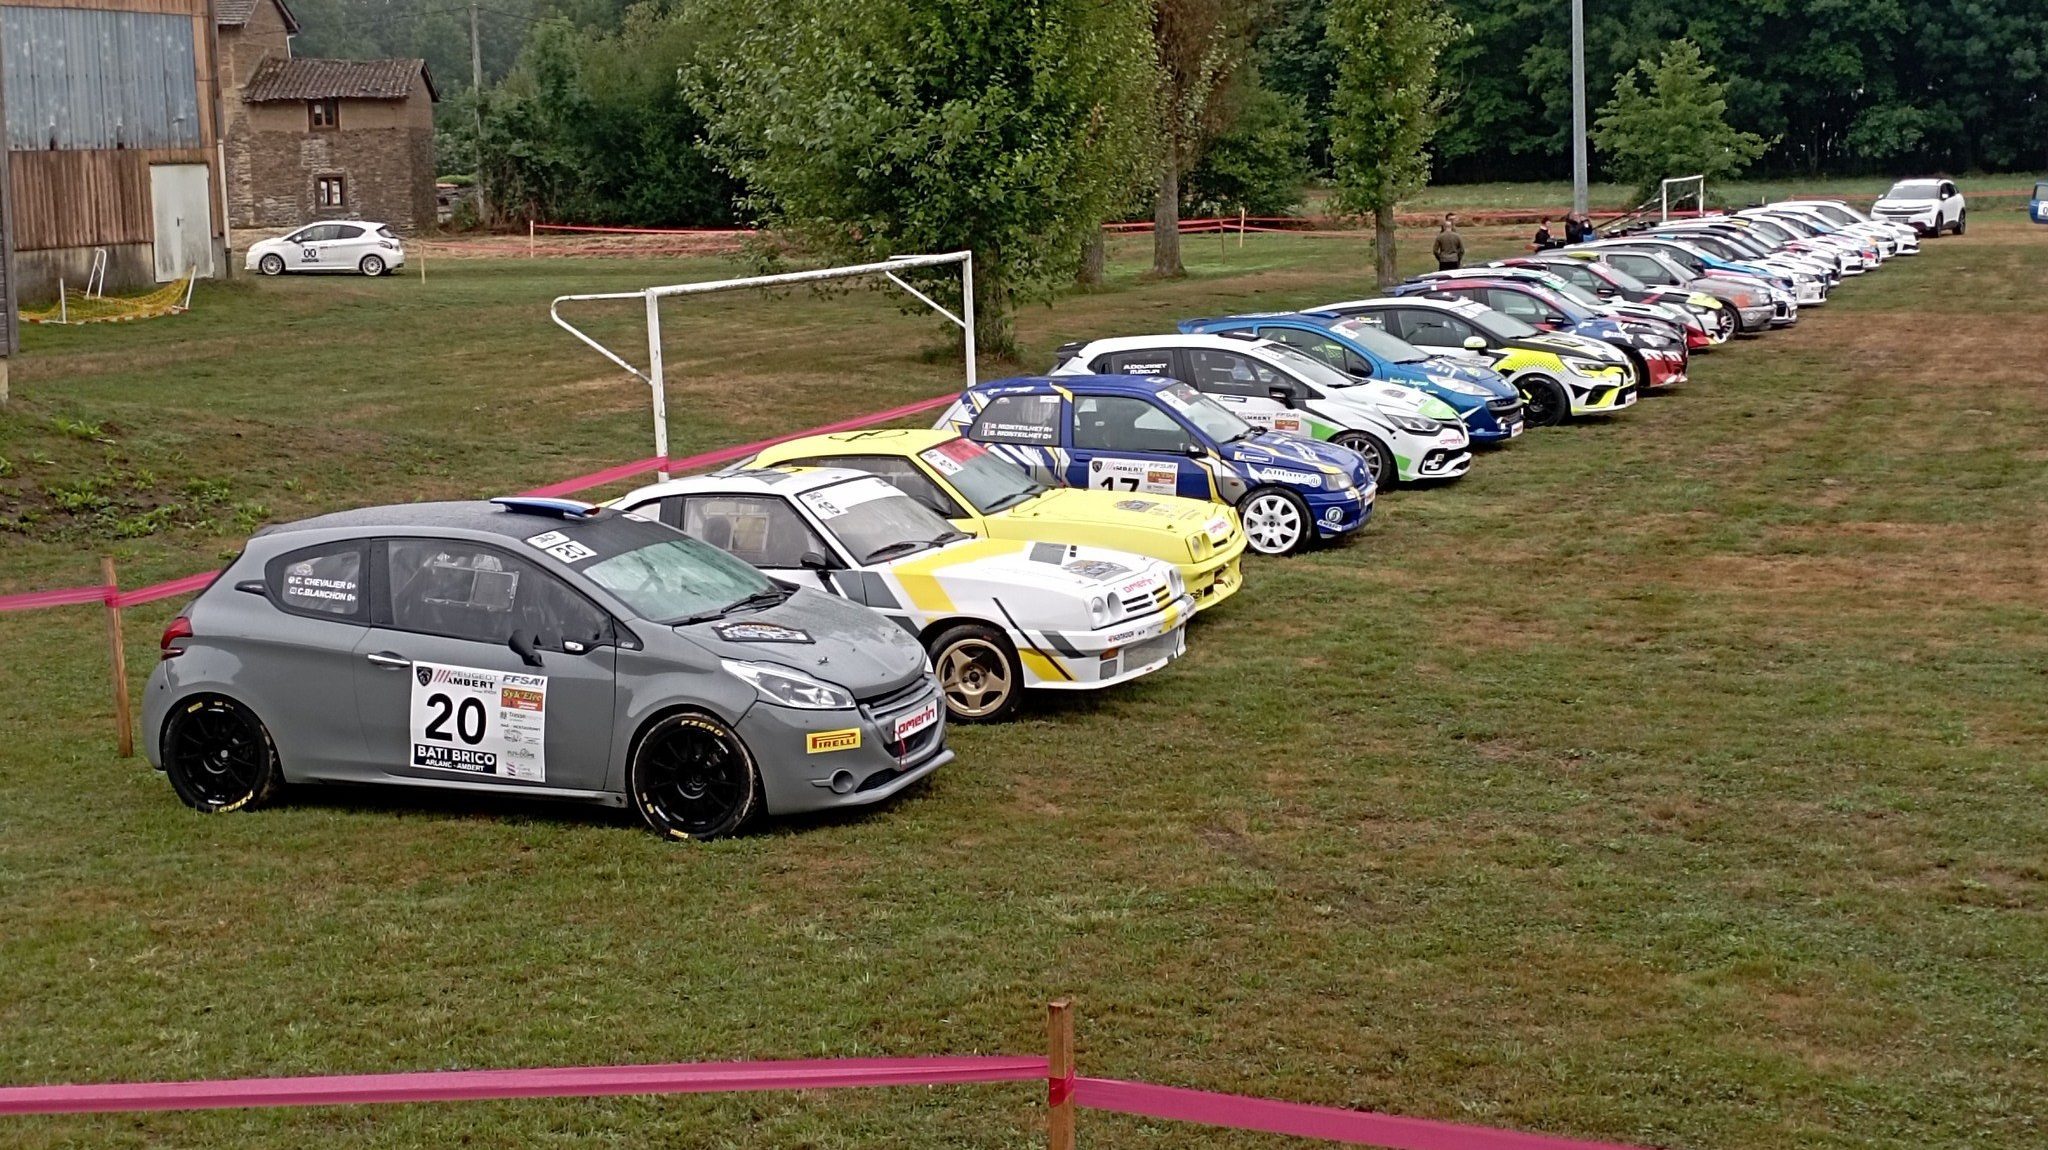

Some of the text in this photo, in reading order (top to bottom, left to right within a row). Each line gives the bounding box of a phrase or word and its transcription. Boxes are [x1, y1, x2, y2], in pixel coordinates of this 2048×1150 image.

[304, 248, 316, 258] 00
[556, 544, 587, 559] 20
[304, 577, 346, 589] CHEVALIER
[448, 677, 495, 689] AMBERT
[425, 692, 487, 746] 20
[898, 705, 936, 734] omerin
[811, 732, 857, 749] PIRELLI
[417, 745, 448, 760] BATI
[452, 749, 495, 765] BRICO
[456, 762, 485, 772] AMBERT
